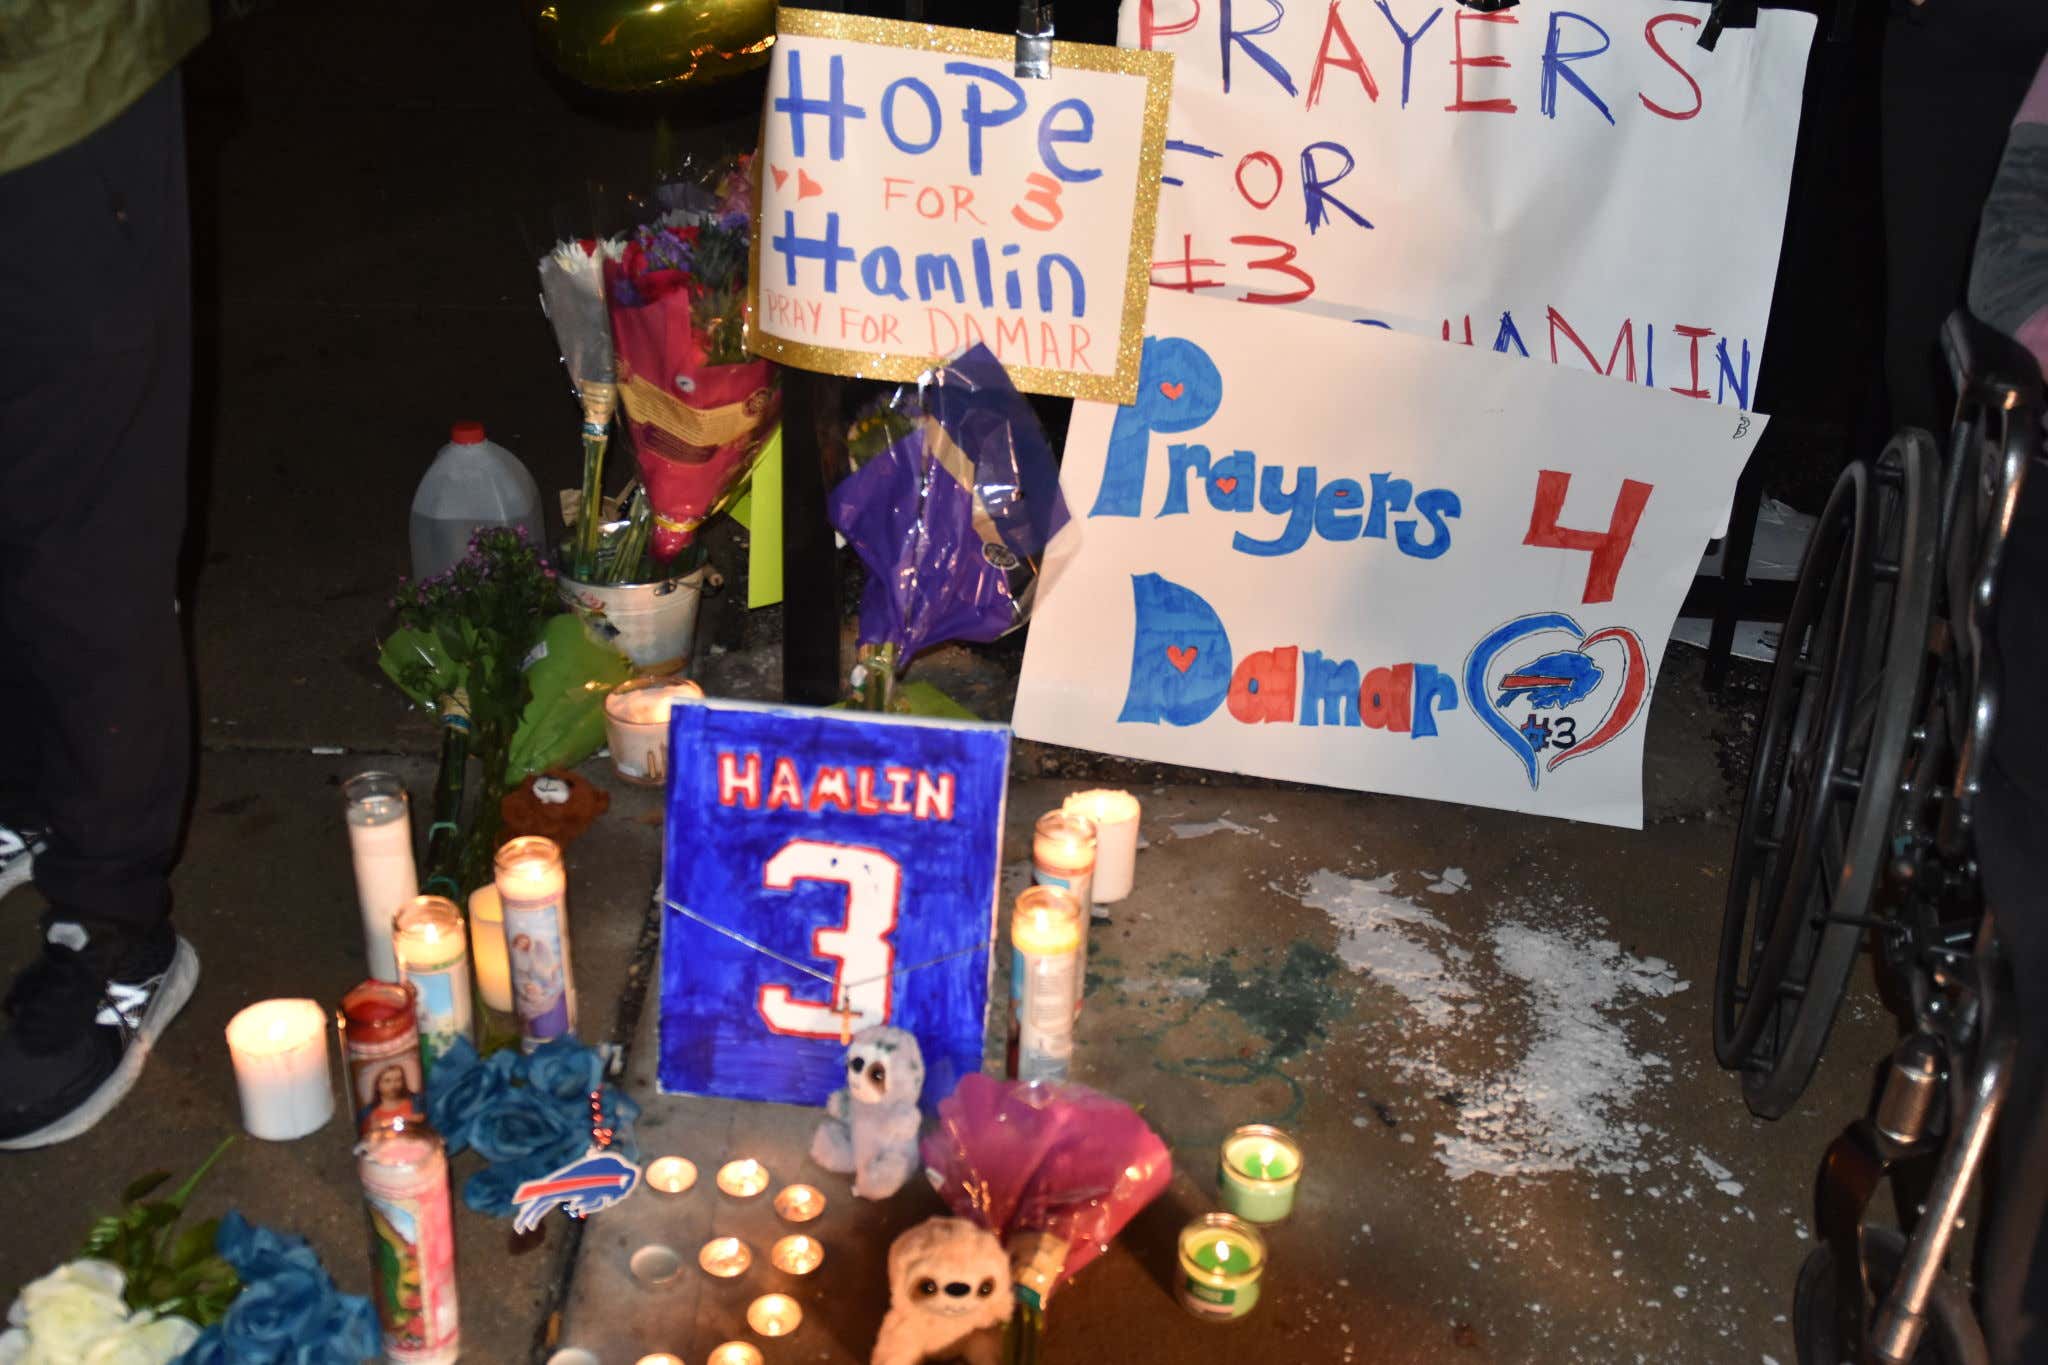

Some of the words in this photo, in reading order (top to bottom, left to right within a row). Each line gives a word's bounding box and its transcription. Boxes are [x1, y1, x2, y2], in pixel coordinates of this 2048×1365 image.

[1139, 0, 1702, 125] PRAYERS
[883, 176, 987, 226] FOR
[1011, 172, 1064, 231] 3
[772, 210, 1085, 318] Hamlin
[764, 289, 822, 336] PRAY
[840, 306, 902, 345] FOR
[925, 307, 1094, 373] DAMAR
[1088, 335, 1461, 559] Prayers
[1522, 469, 1654, 605] 4
[1117, 572, 1458, 740] Damar
[716, 751, 956, 821] HAMLIN
[1520, 713, 1577, 753] #3
[757, 837, 902, 1040] 3
